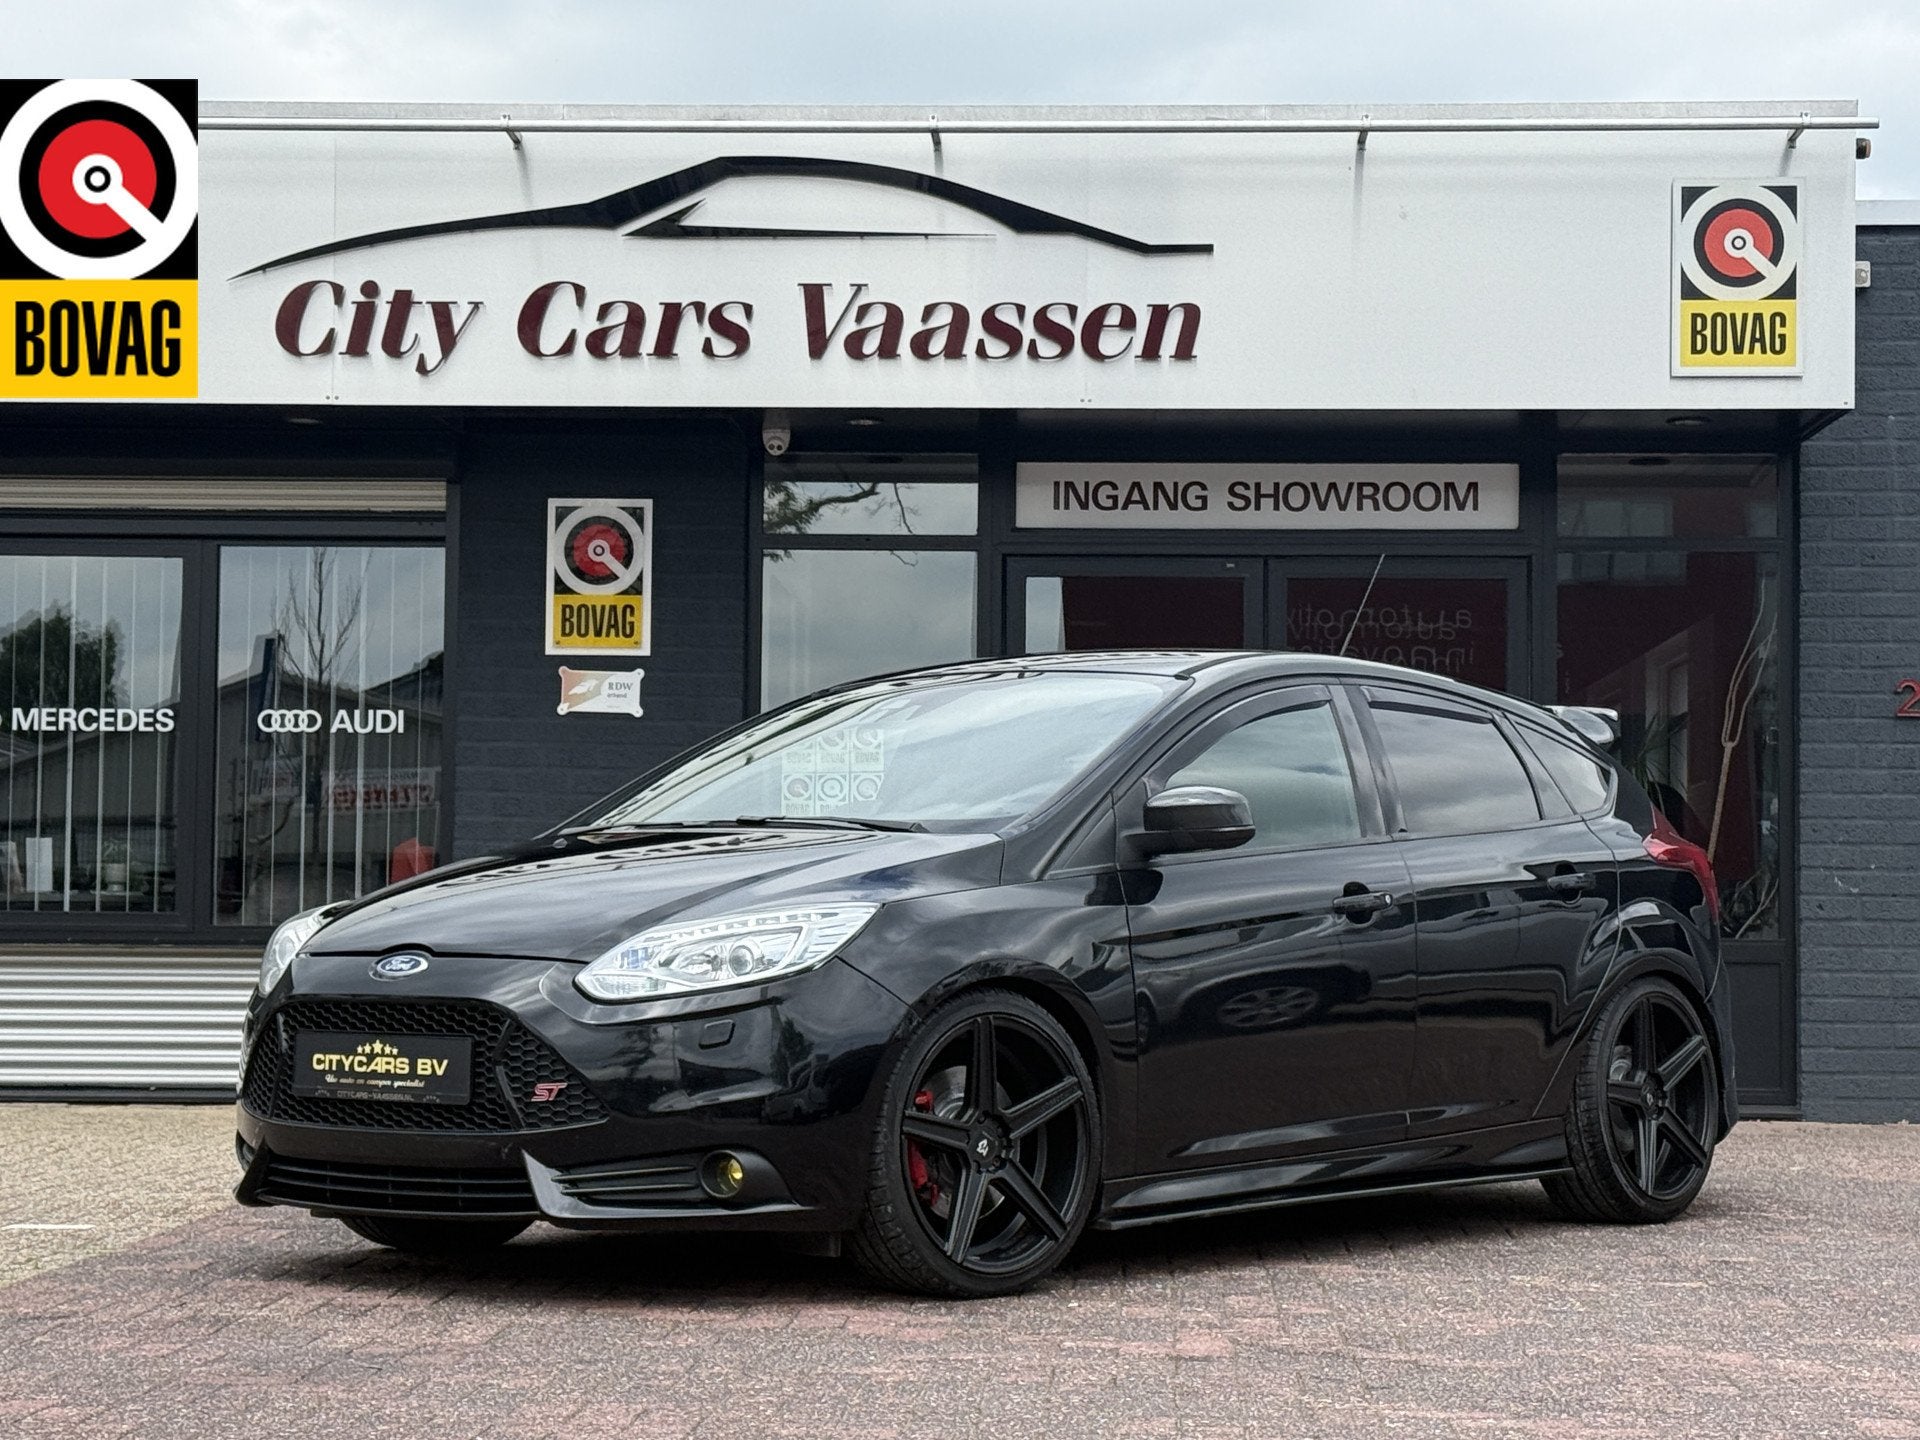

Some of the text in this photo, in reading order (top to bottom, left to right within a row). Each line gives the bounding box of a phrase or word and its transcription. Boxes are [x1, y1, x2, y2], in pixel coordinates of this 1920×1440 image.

[274, 279, 1202, 376] City Cars Vaassen
[1690, 311, 1787, 355] BOVAG
[1052, 480, 1480, 512] INGANG SHOWROOM
[560, 603, 635, 638] BOVAG
[607, 682, 633, 691] RDW
[1896, 678, 1920, 718] 2
[12, 708, 175, 733] MERCEDES
[330, 709, 404, 733] AUDI
[312, 1053, 449, 1076] CITYCARS BV
[531, 1083, 568, 1101] ST
